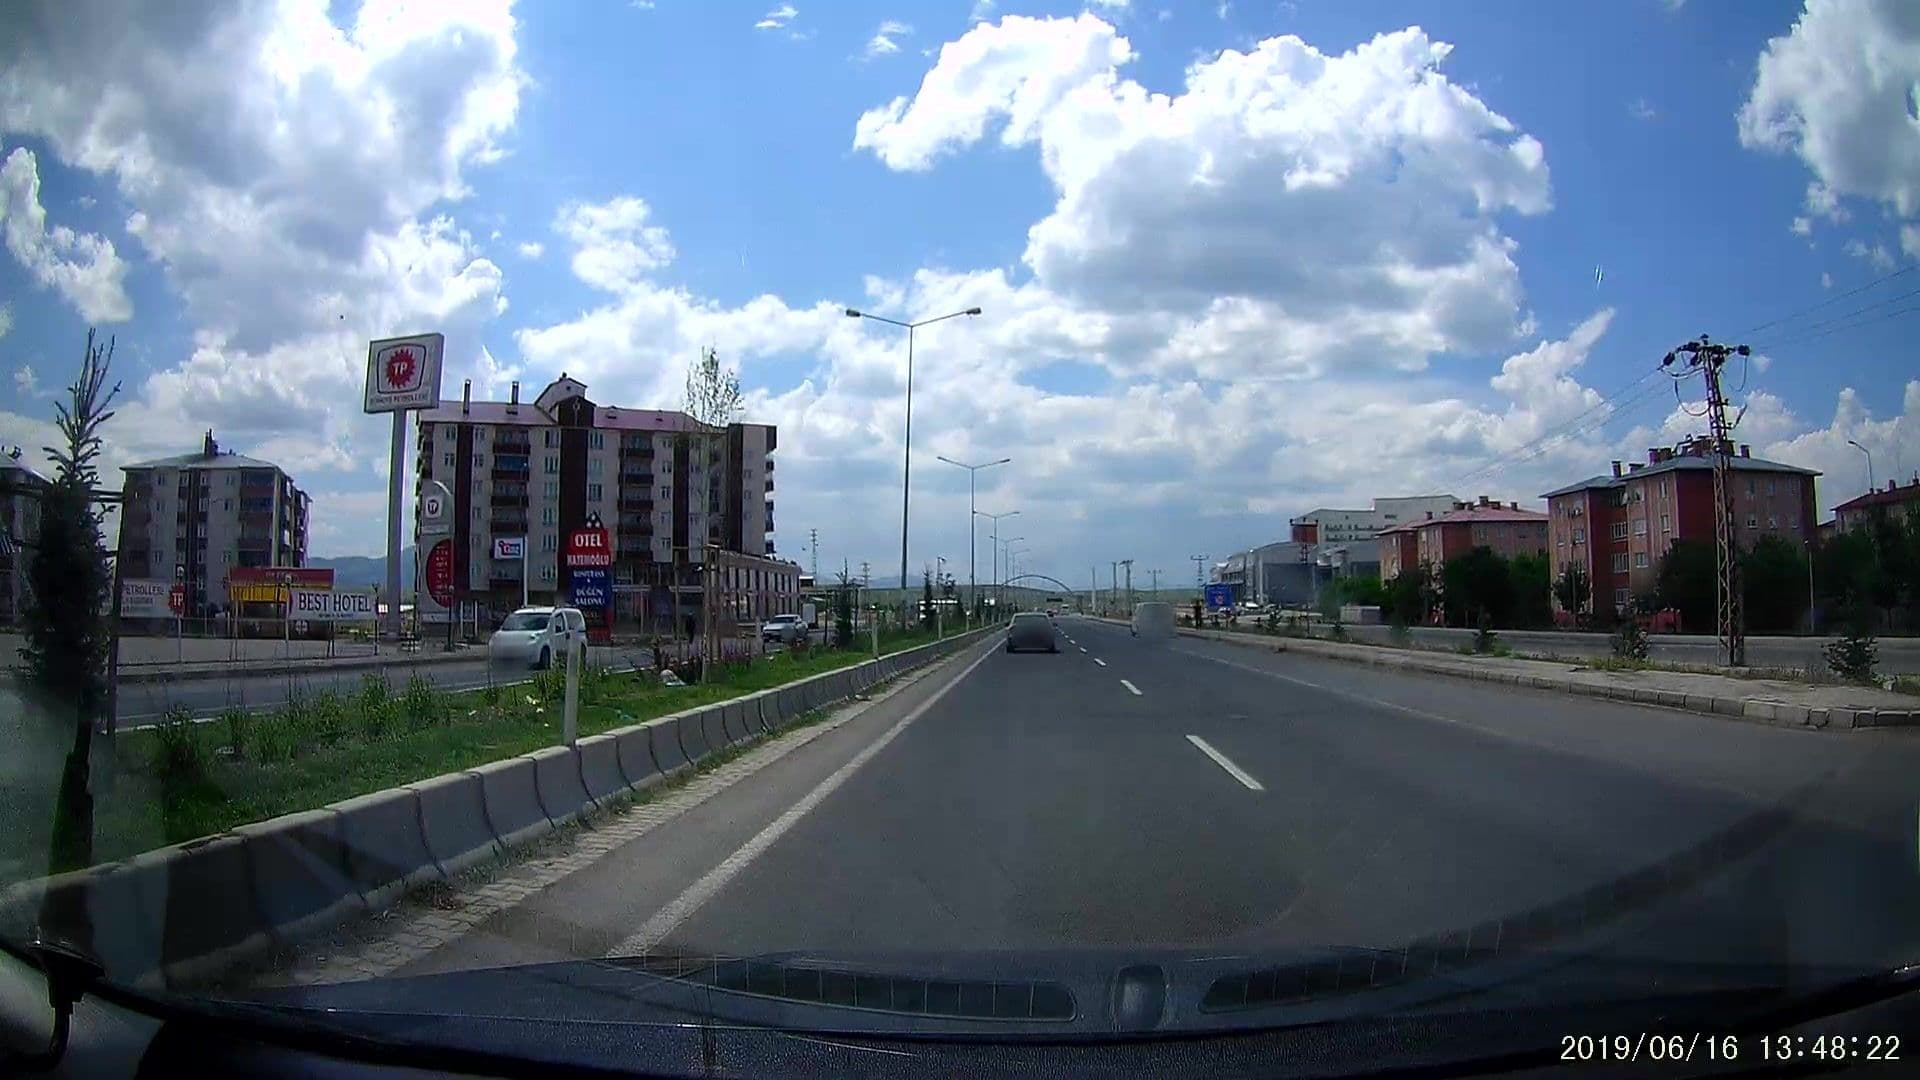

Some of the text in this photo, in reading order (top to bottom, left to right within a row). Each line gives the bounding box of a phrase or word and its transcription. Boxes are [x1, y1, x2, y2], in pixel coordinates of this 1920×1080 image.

[392, 361, 408, 376] TP
[575, 533, 603, 547] OTEL
[172, 592, 184, 606] TP
[298, 592, 329, 612] BEST
[333, 594, 371, 612] HOTEL
